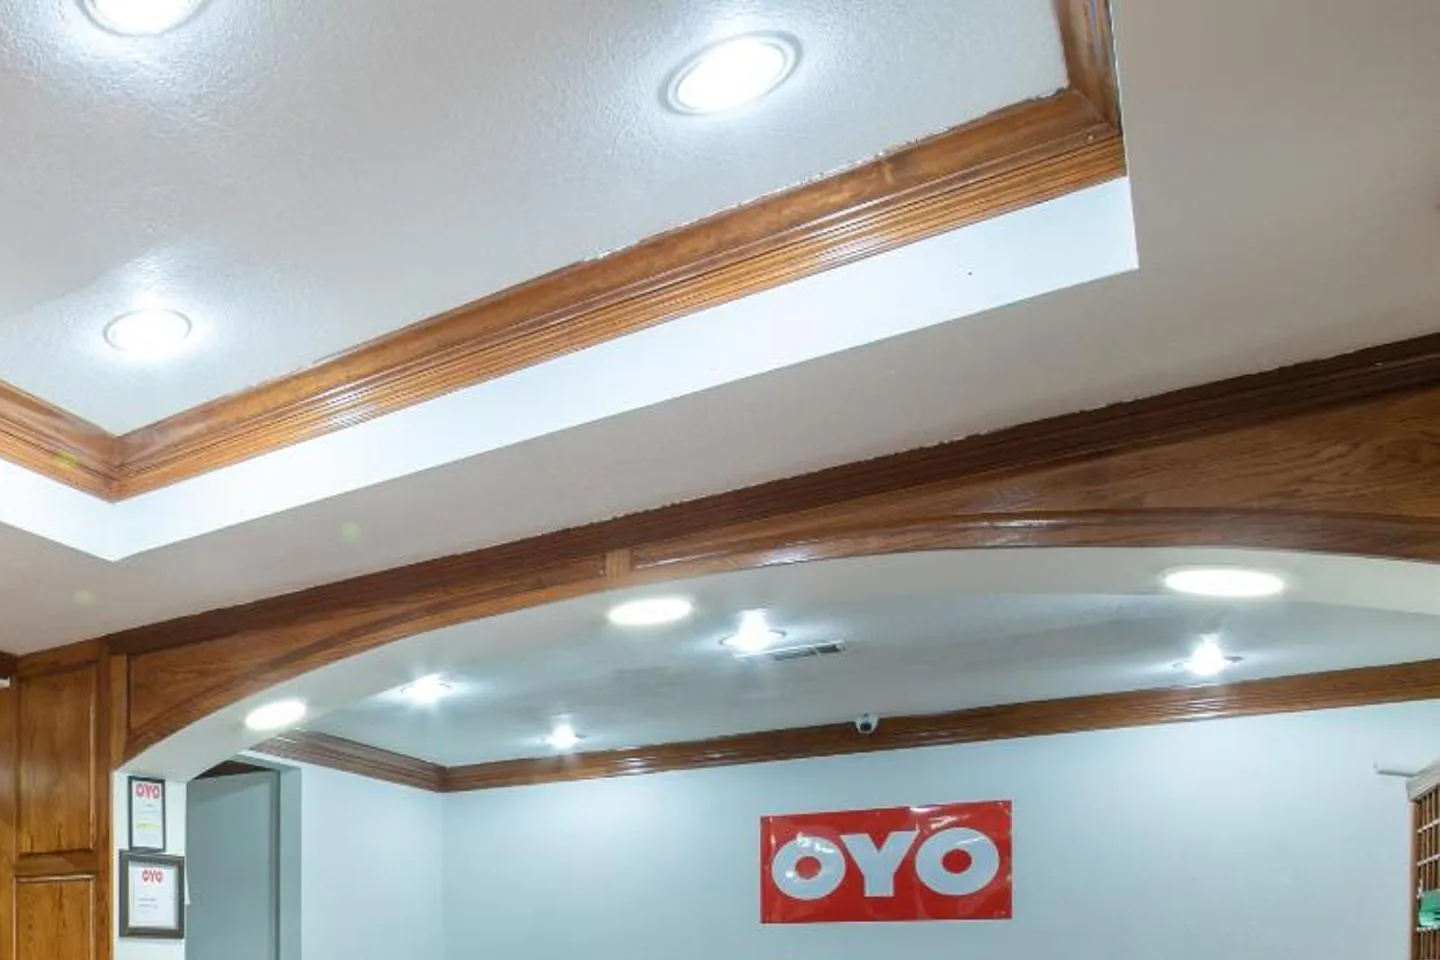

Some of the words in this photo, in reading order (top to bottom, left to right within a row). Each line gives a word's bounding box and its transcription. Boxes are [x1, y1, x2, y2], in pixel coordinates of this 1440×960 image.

[136, 783, 160, 799] OYO
[771, 826, 1000, 900] OYO
[142, 869, 164, 883] OYO
